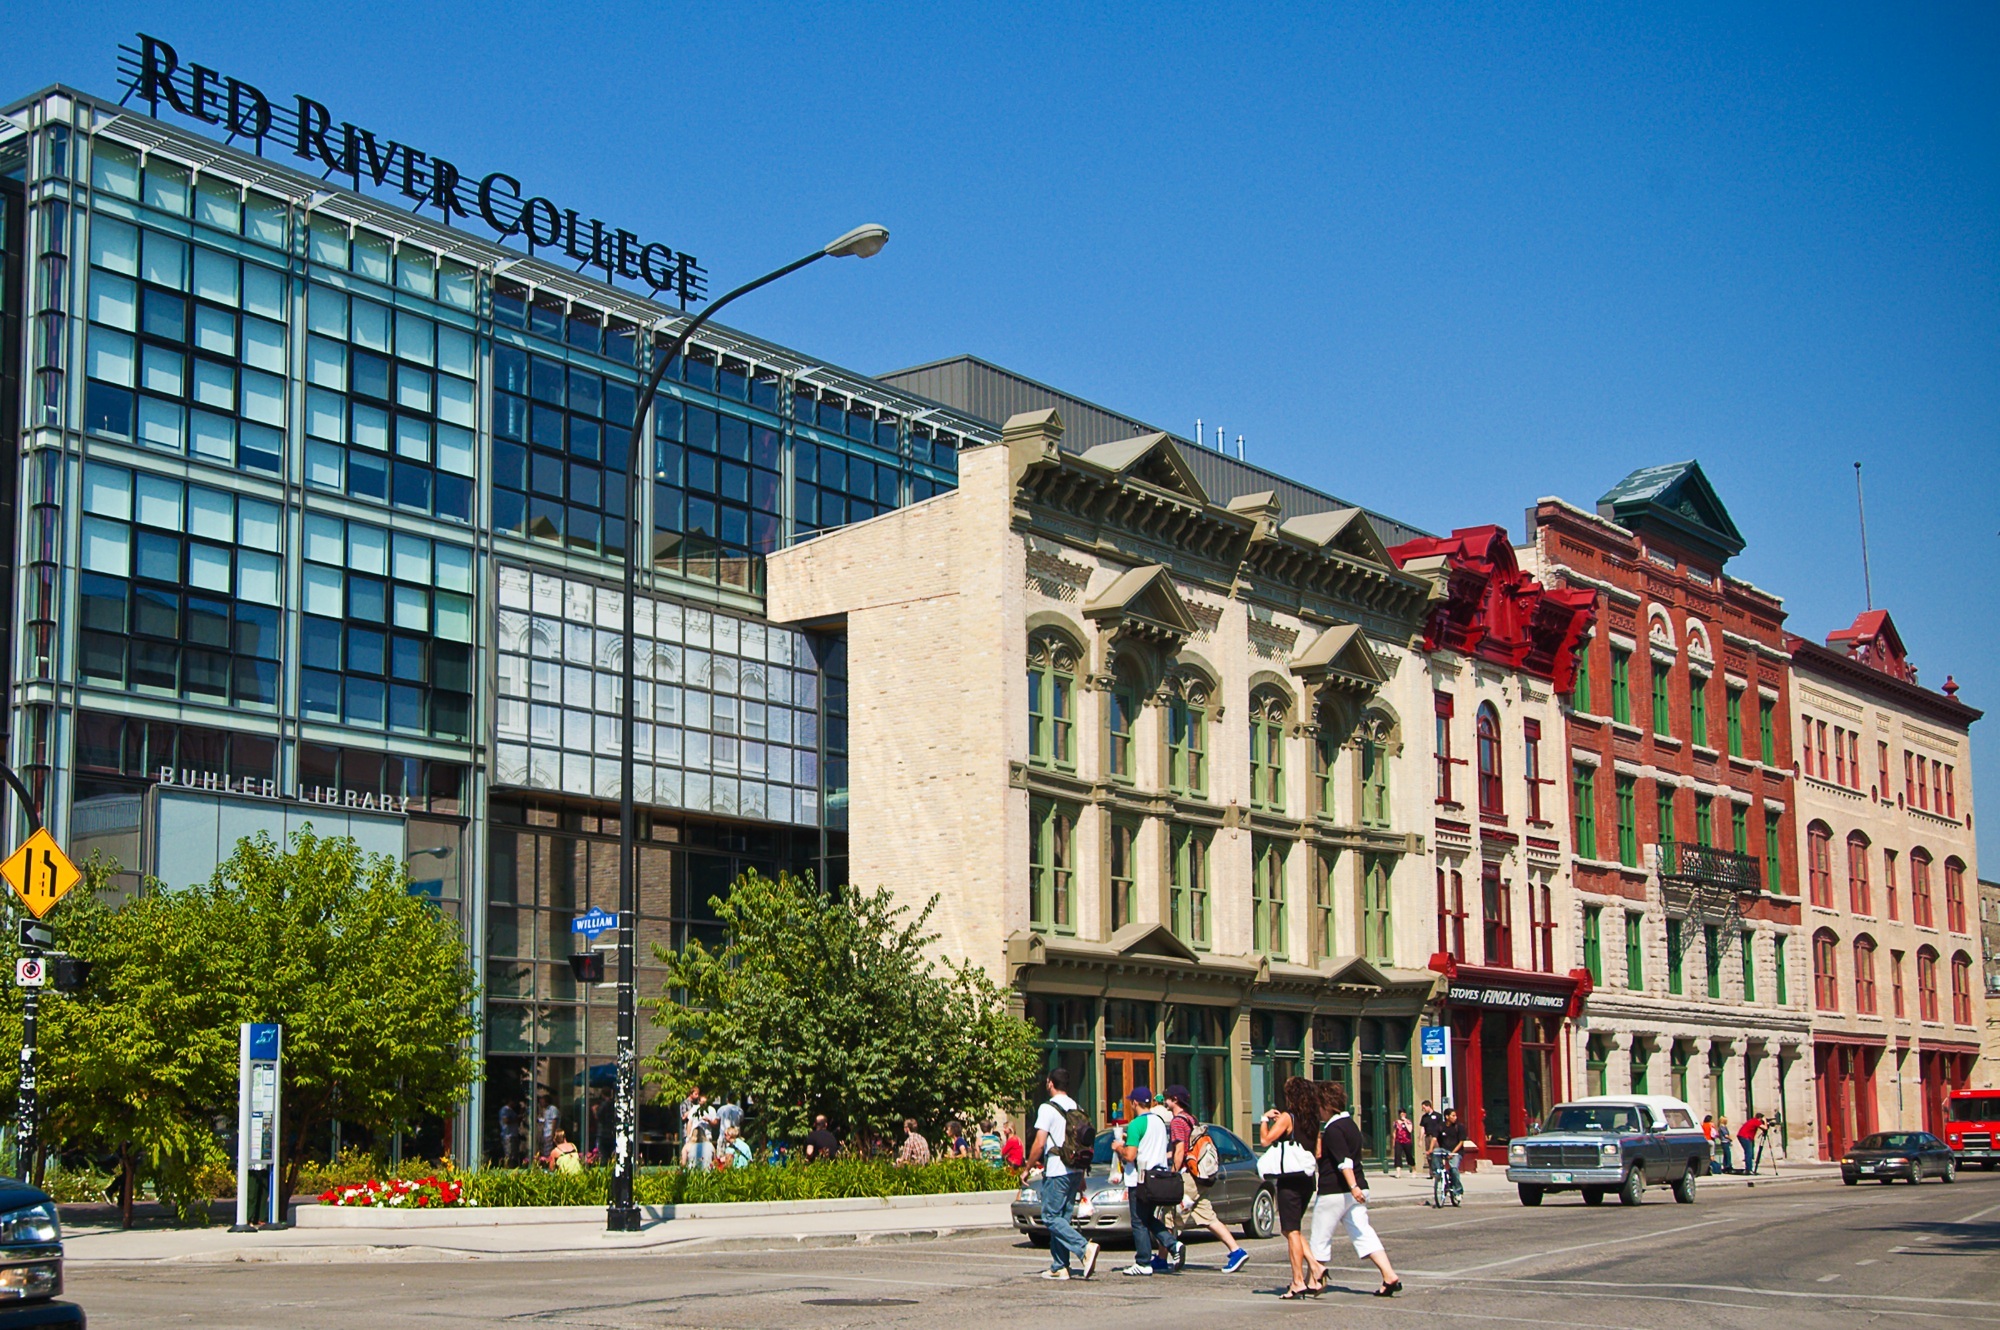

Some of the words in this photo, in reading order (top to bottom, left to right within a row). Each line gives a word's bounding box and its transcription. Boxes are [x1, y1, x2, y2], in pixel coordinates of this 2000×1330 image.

[135, 32, 273, 139] RED
[292, 93, 469, 219] RIVER
[160, 765, 279, 798] BUHLER
[299, 783, 410, 813] LIBRARY
[576, 916, 613, 930] WILLIAM
[1449, 988, 1479, 1000] STOVES
[1482, 989, 1532, 1007] FINDLAYS
